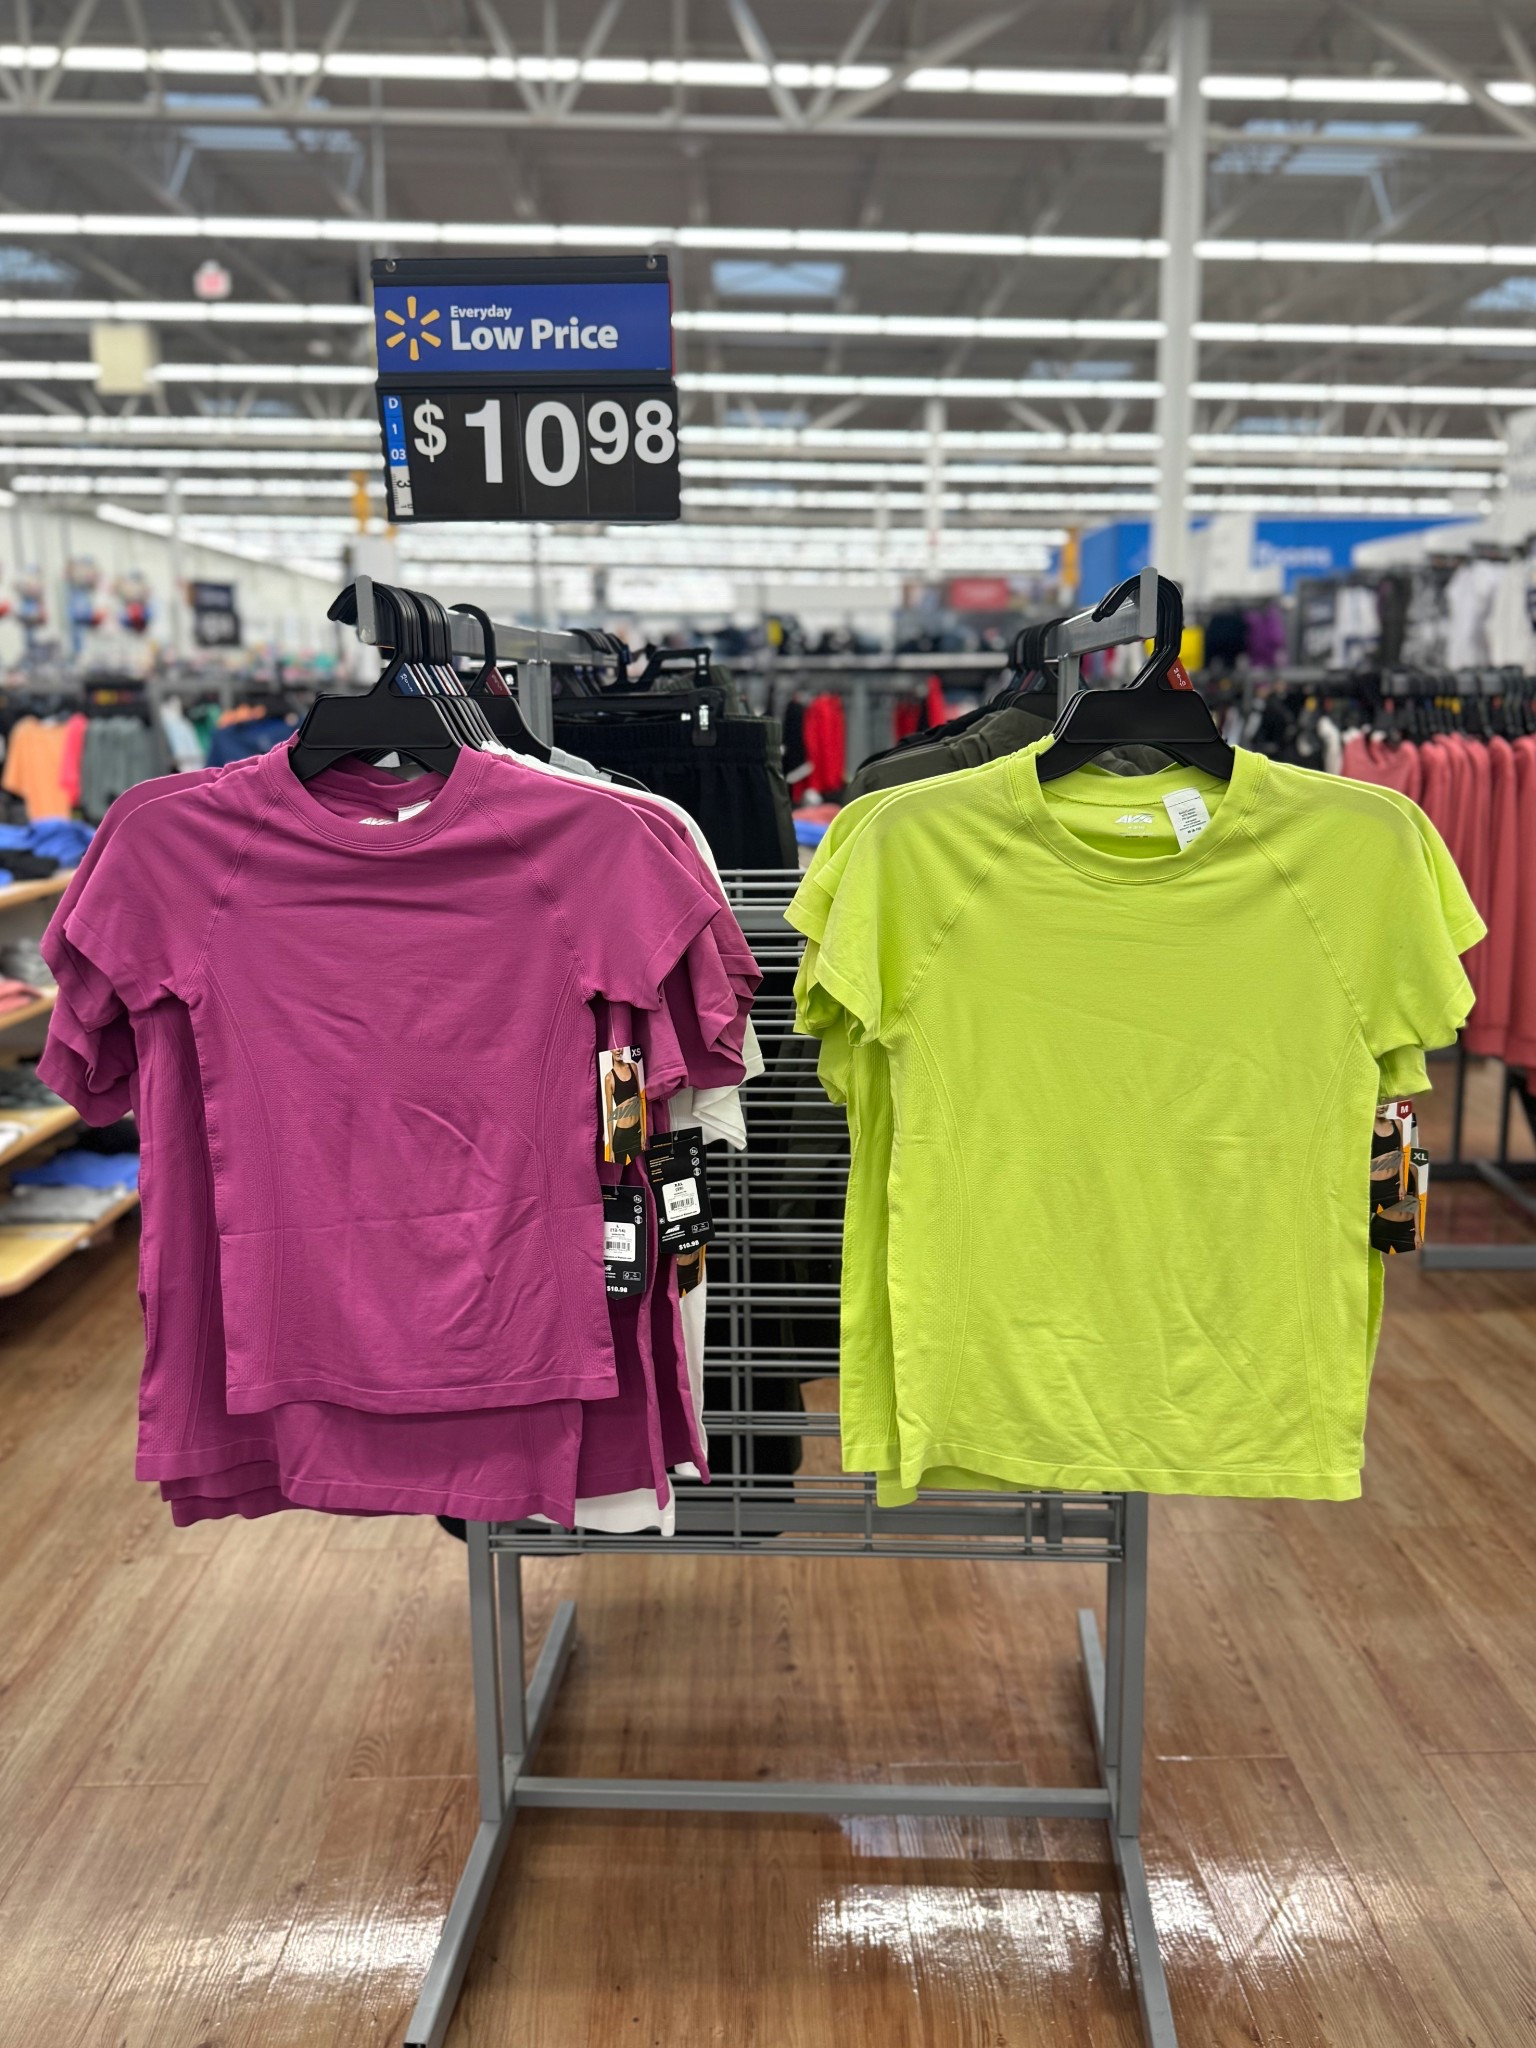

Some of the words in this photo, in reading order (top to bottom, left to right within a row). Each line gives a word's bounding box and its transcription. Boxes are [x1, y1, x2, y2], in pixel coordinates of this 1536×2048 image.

[450, 305, 512, 320] Everyday
[451, 320, 524, 350] Low
[531, 317, 619, 350] Price
[388, 398, 398, 409] D
[392, 423, 397, 435] 1
[390, 449, 406, 460] 03
[631, 1048, 641, 1057] XS
[1400, 1105, 1409, 1113] M
[1413, 1152, 1427, 1161] XL
